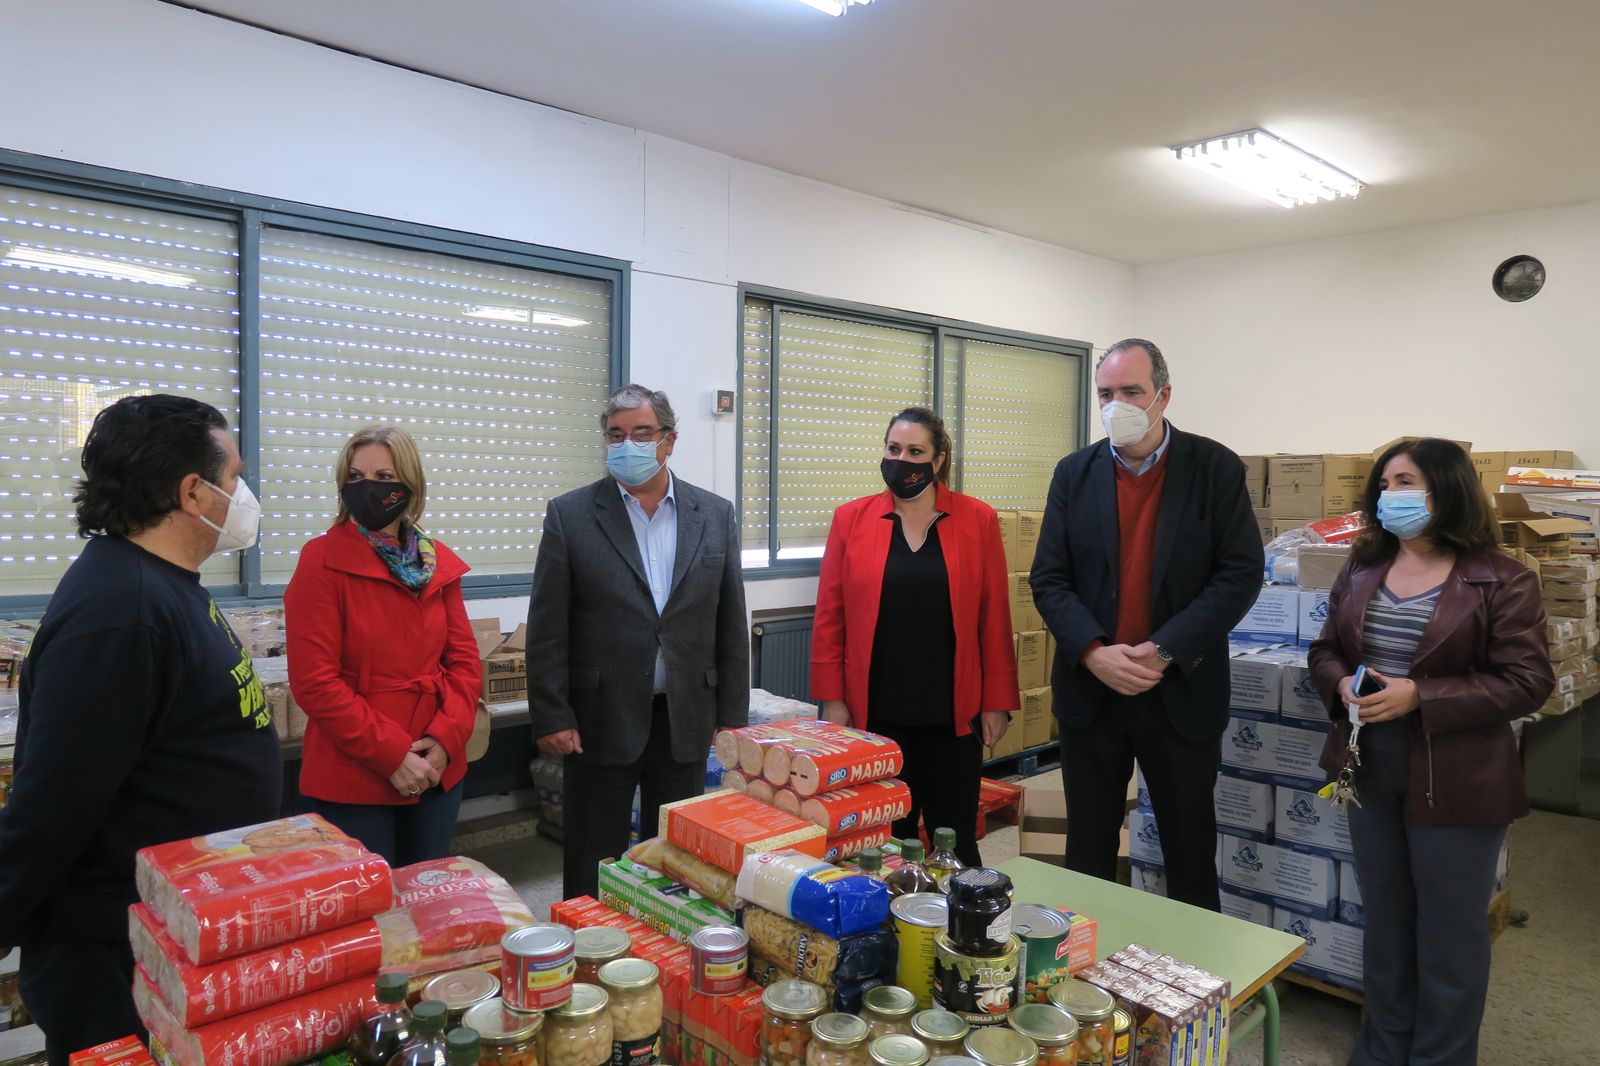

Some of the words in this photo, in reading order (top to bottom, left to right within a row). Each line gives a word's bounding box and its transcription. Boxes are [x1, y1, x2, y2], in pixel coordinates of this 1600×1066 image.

[829, 768, 847, 782] SIRO
[850, 758, 896, 783] MARIA
[839, 813, 857, 828] SIRO
[860, 800, 905, 829] MARIA
[825, 848, 838, 860] IRO
